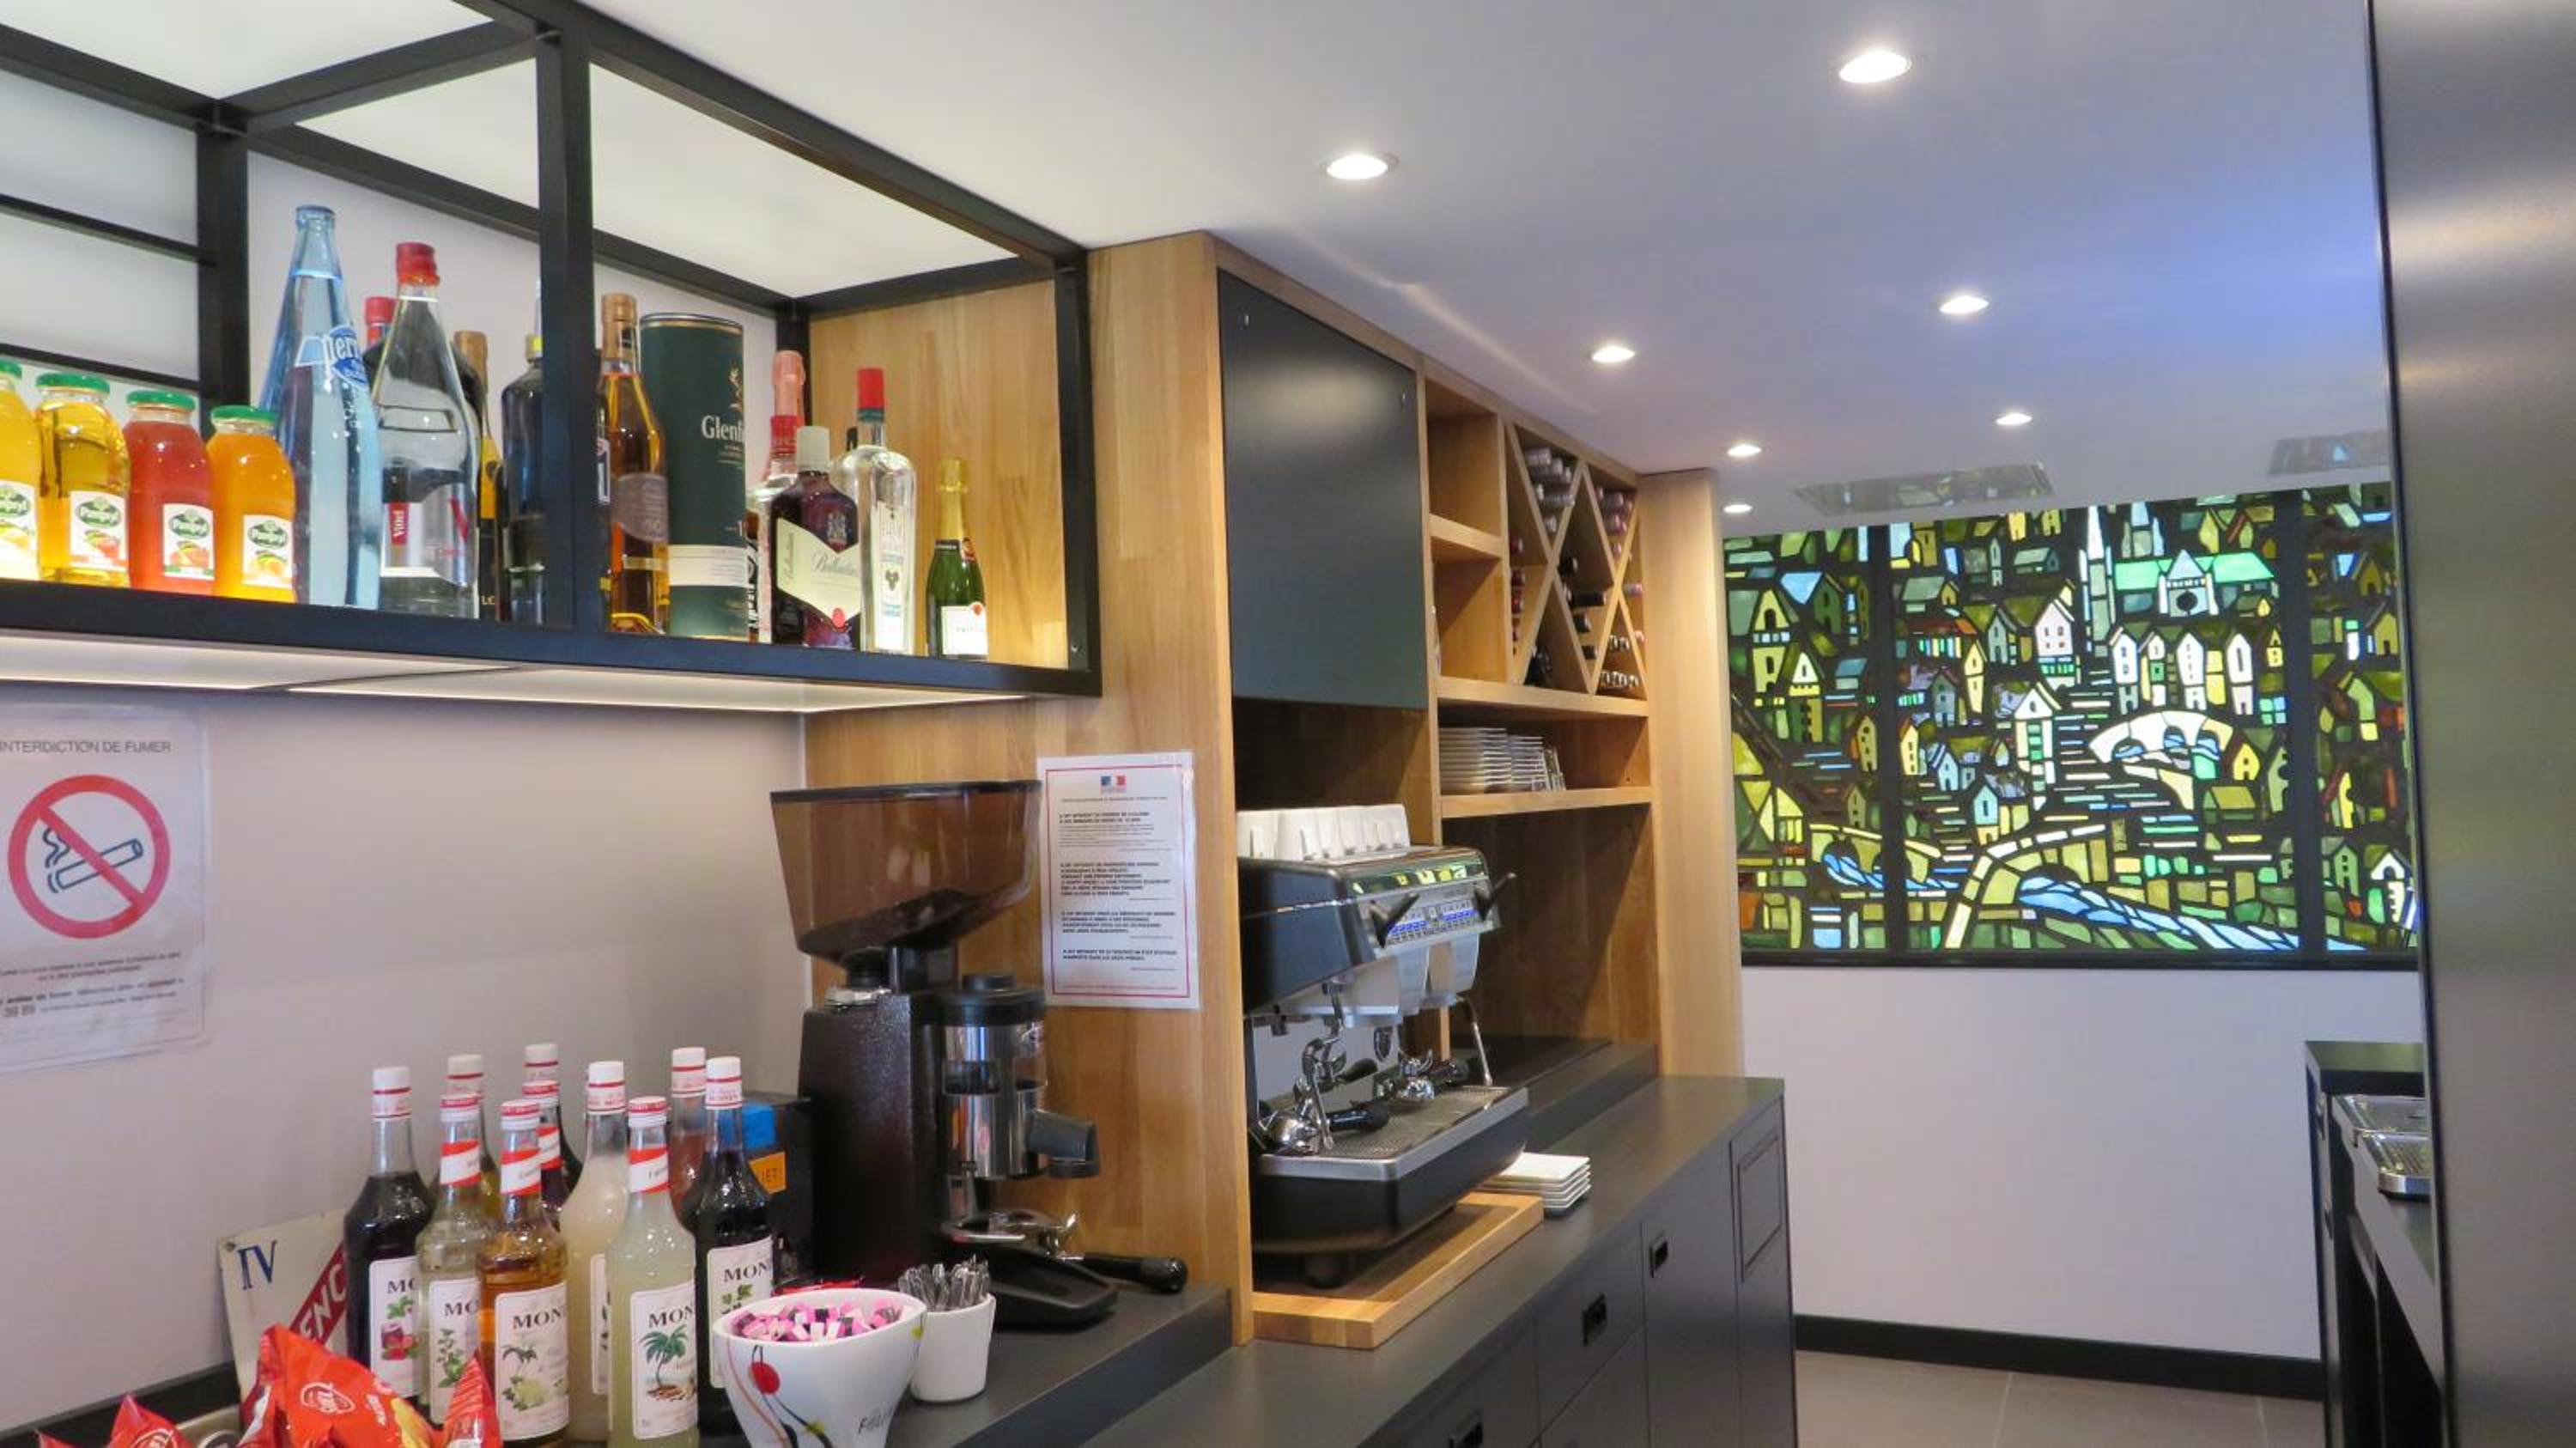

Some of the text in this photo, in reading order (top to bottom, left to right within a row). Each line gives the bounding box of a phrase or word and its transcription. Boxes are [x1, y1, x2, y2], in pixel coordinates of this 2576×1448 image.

[102, 741, 121, 753] DE
[125, 741, 172, 753] FUMER
[238, 1239, 278, 1291] IV
